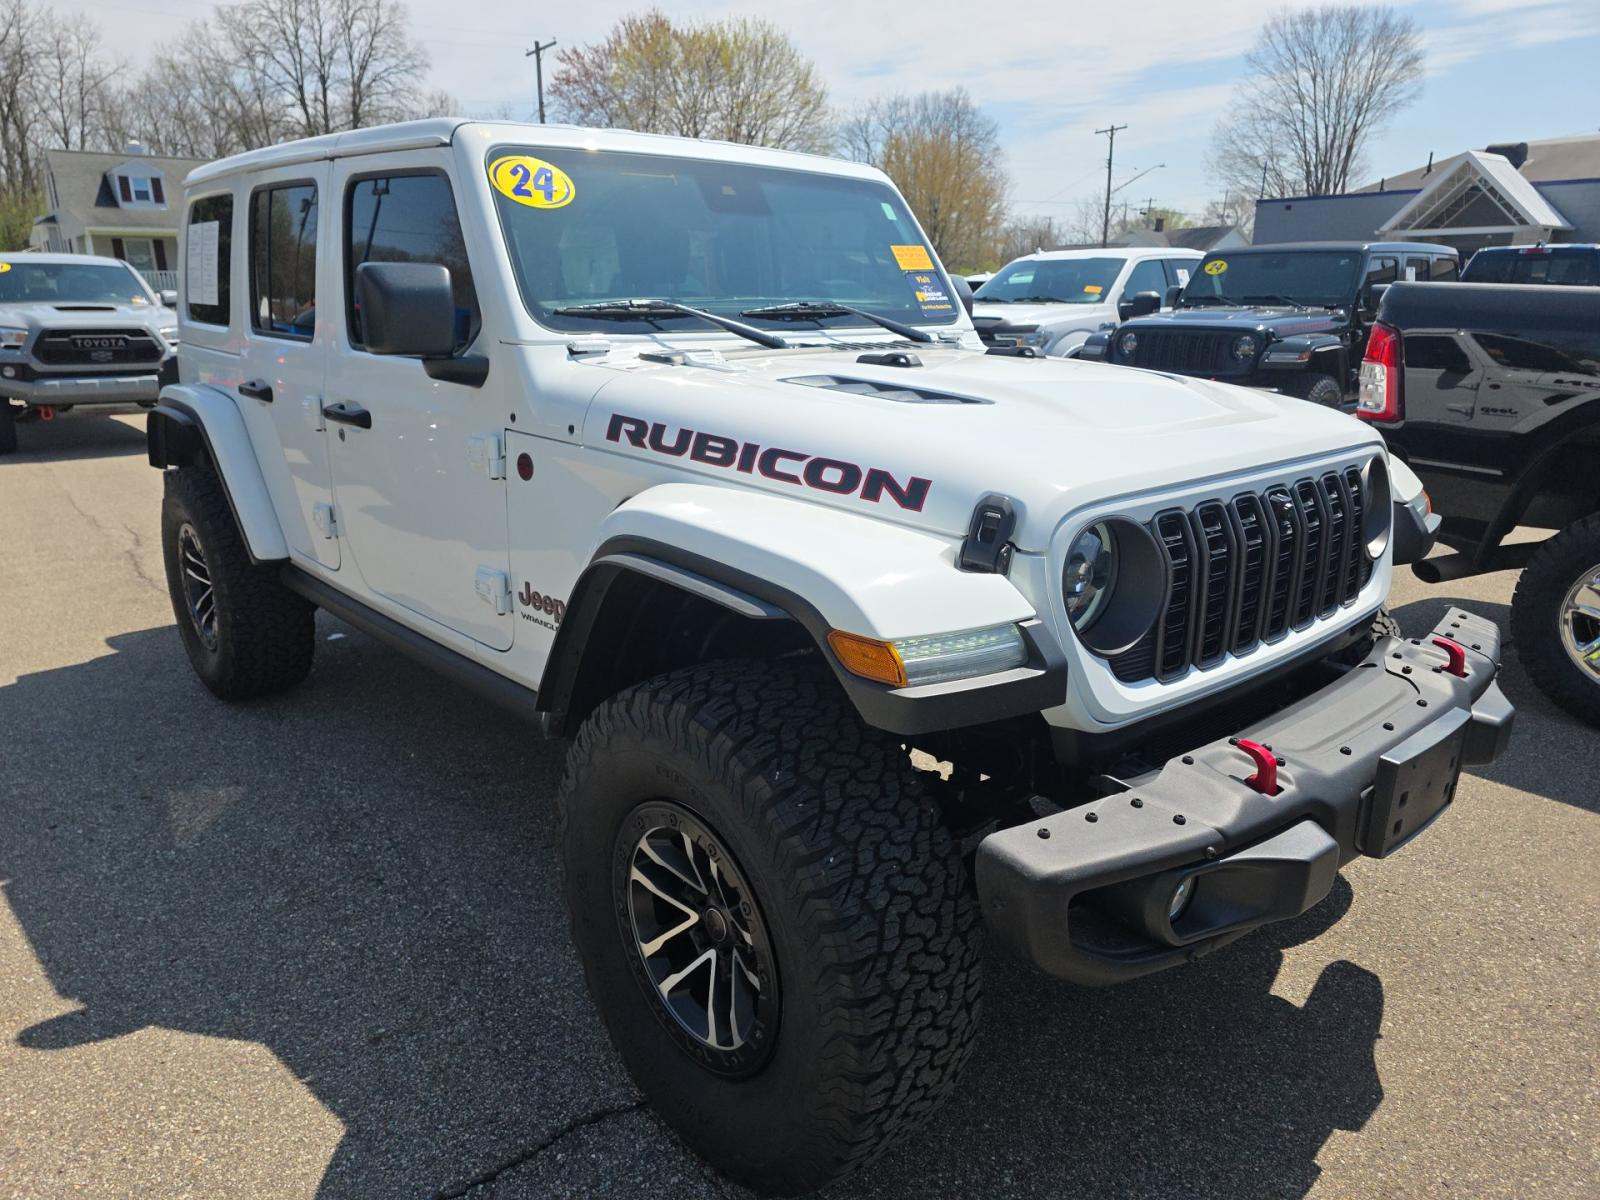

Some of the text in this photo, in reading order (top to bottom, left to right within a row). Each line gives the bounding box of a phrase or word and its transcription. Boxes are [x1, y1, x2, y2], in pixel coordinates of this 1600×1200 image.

[509, 164, 554, 202] 24
[75, 338, 126, 348] TOYOTA
[605, 413, 932, 513] RUBICON
[518, 581, 567, 624] Jeep
